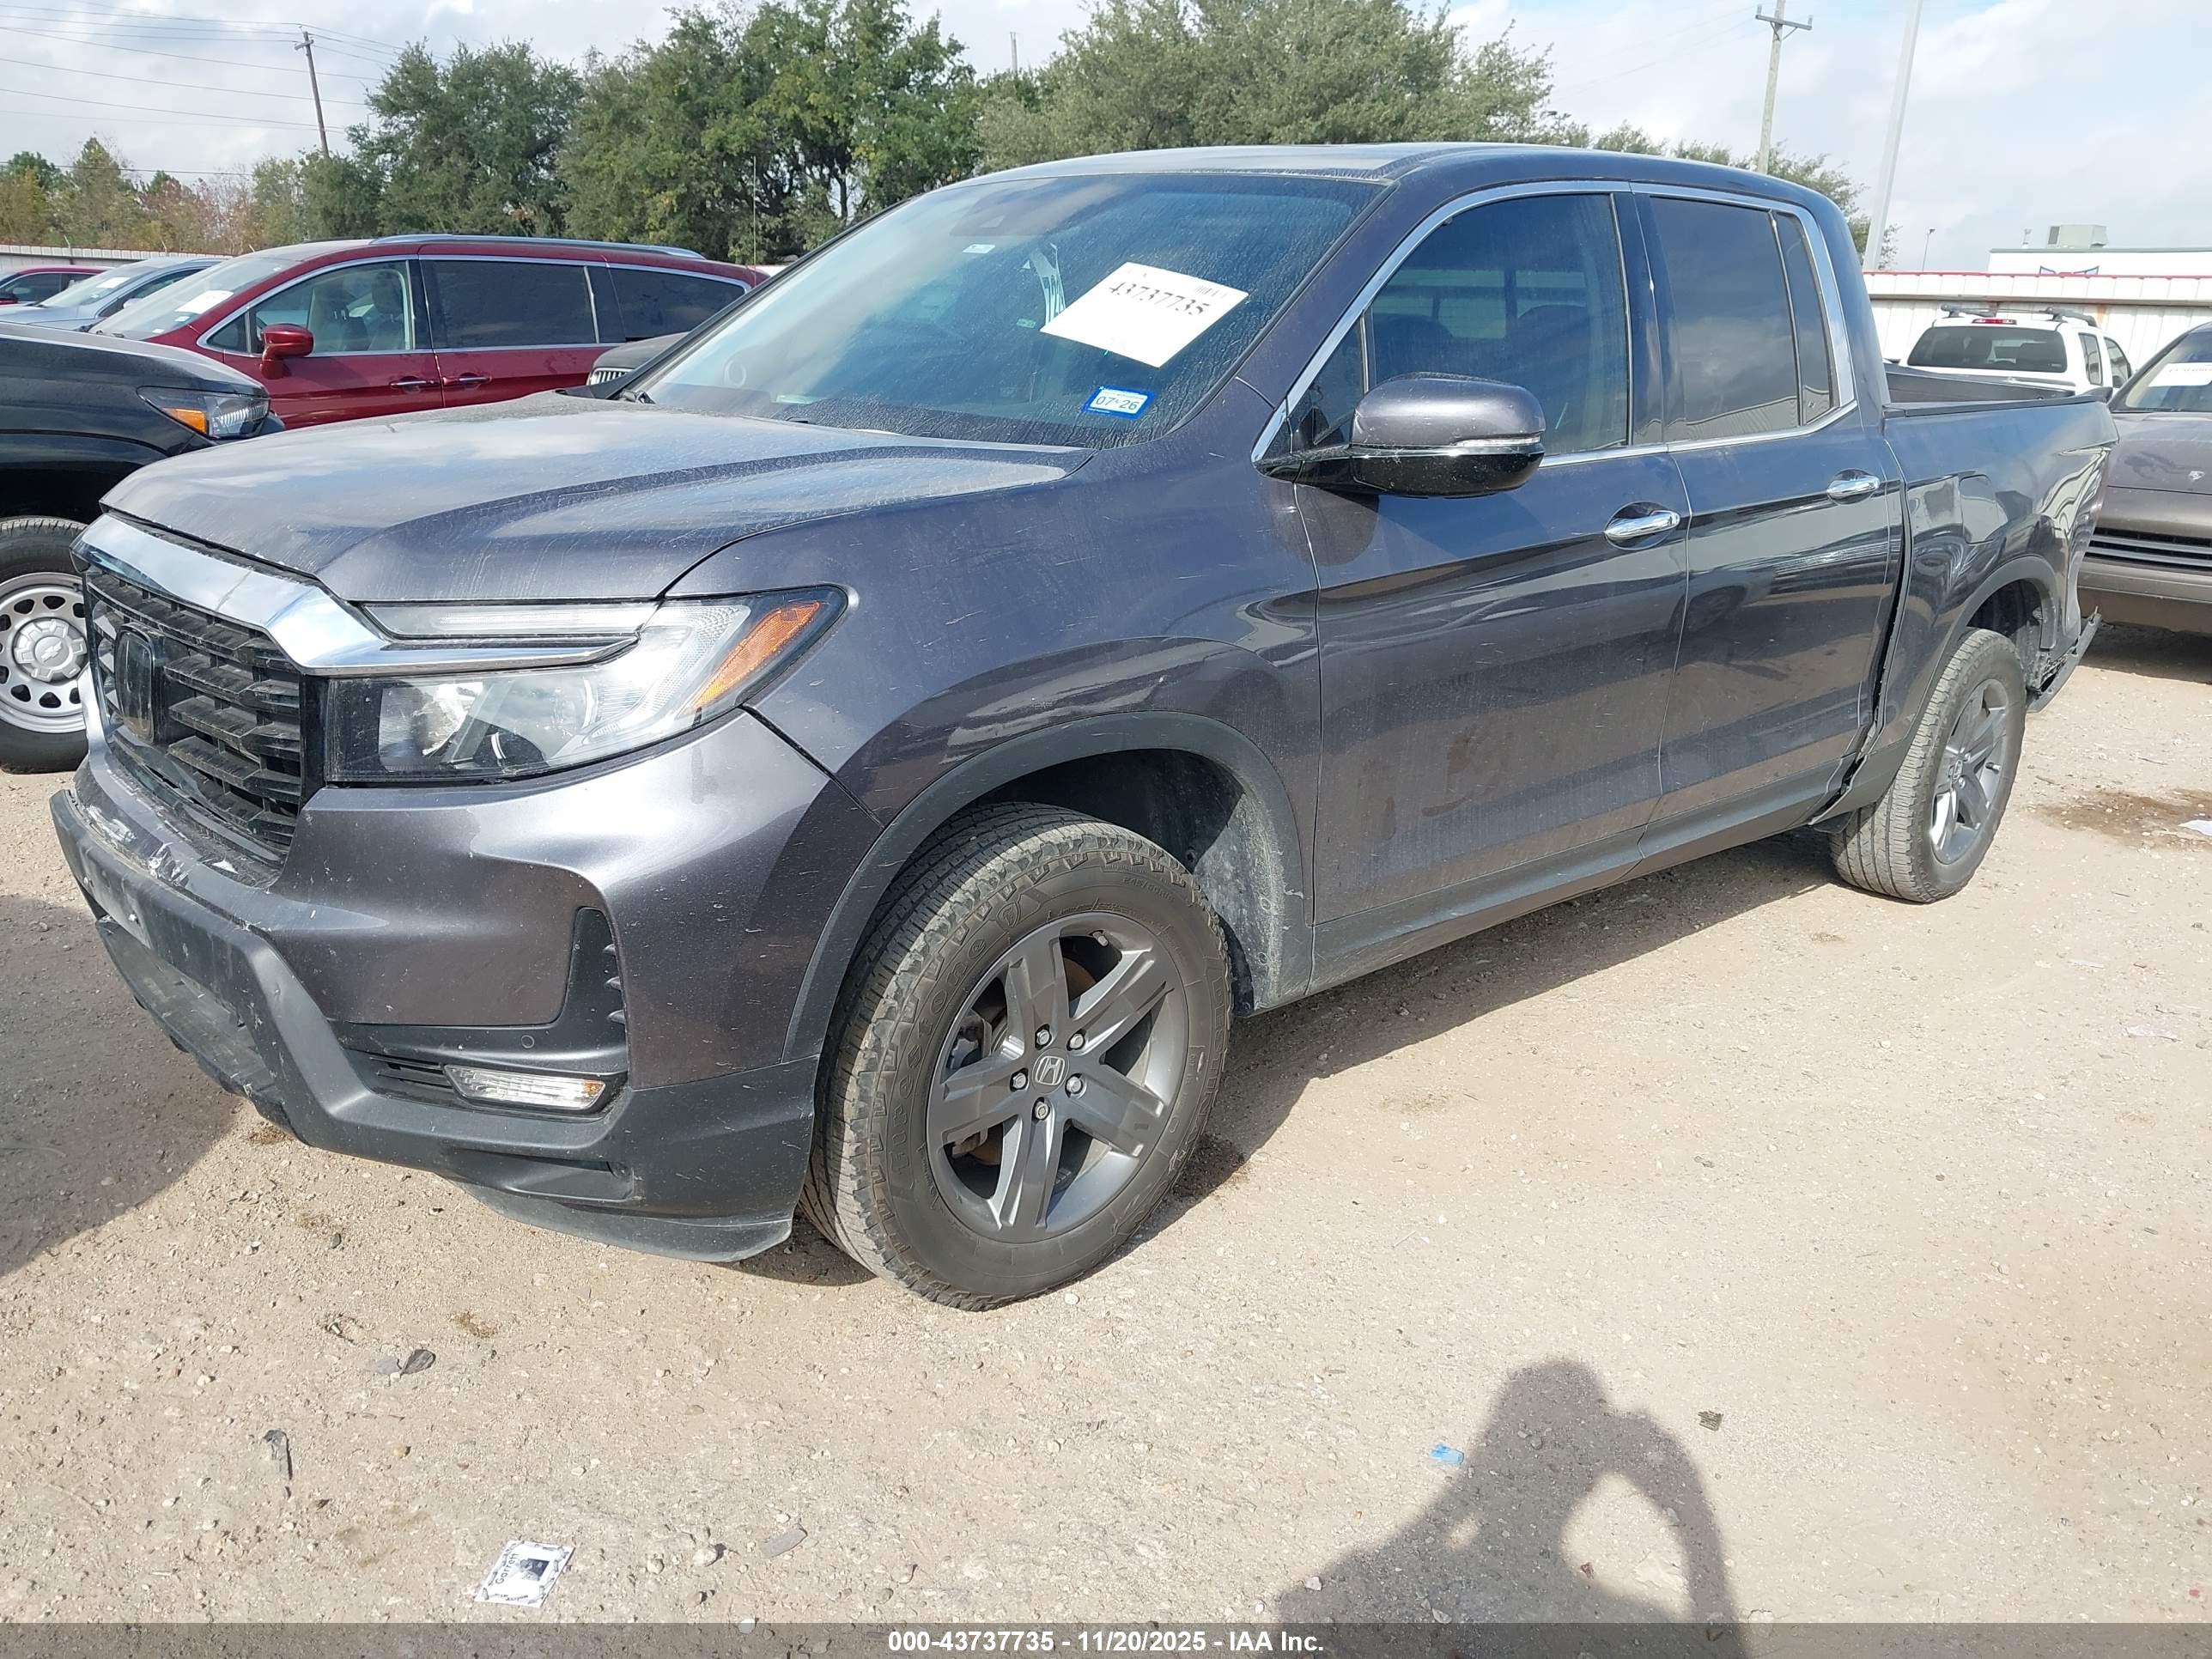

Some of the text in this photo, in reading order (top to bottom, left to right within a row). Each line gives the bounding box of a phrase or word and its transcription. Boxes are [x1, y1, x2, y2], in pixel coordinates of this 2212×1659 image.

[1109, 282, 1211, 316] 43737735
[1095, 396, 1115, 406] 07
[1118, 399, 1139, 410] 26
